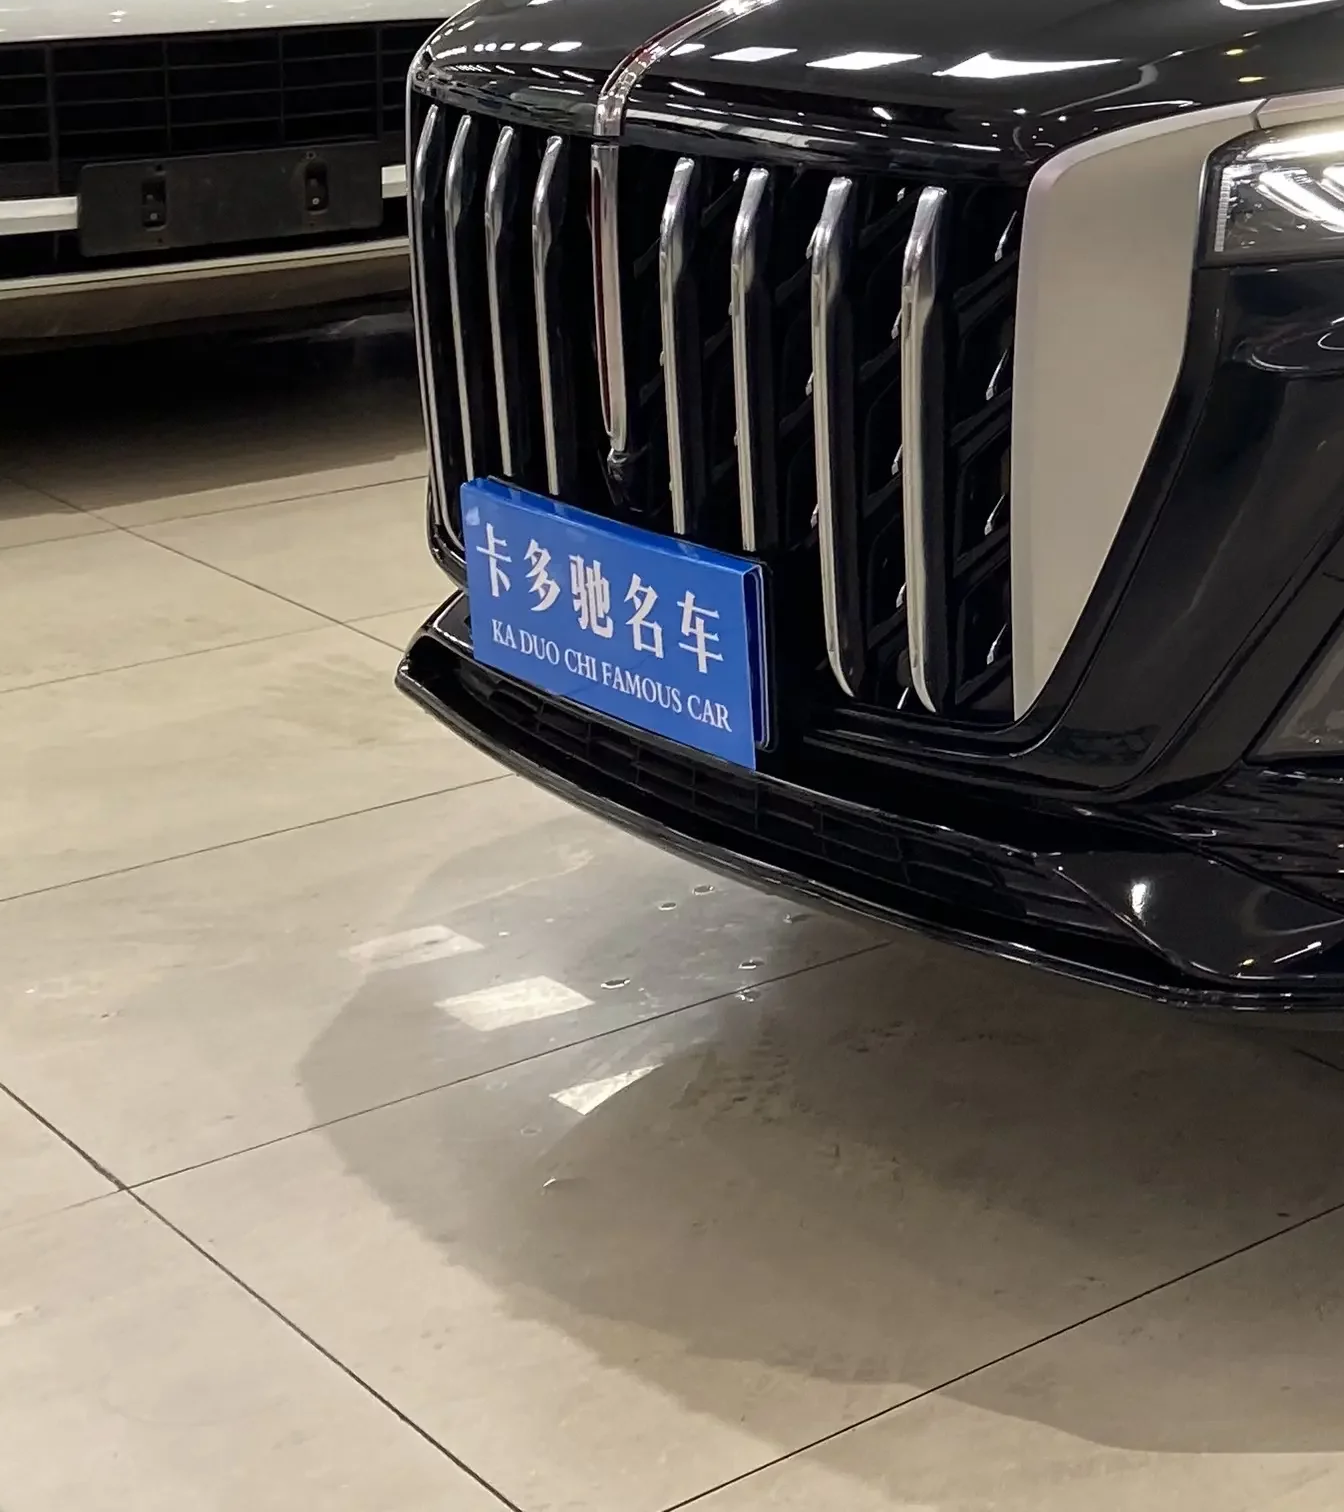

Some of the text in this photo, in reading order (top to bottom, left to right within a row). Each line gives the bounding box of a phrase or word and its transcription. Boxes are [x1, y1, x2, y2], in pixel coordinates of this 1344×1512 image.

[476, 523, 724, 674] 卡多驰名车
[491, 619, 732, 733] KA DUO CHI FAMOUS CAR
